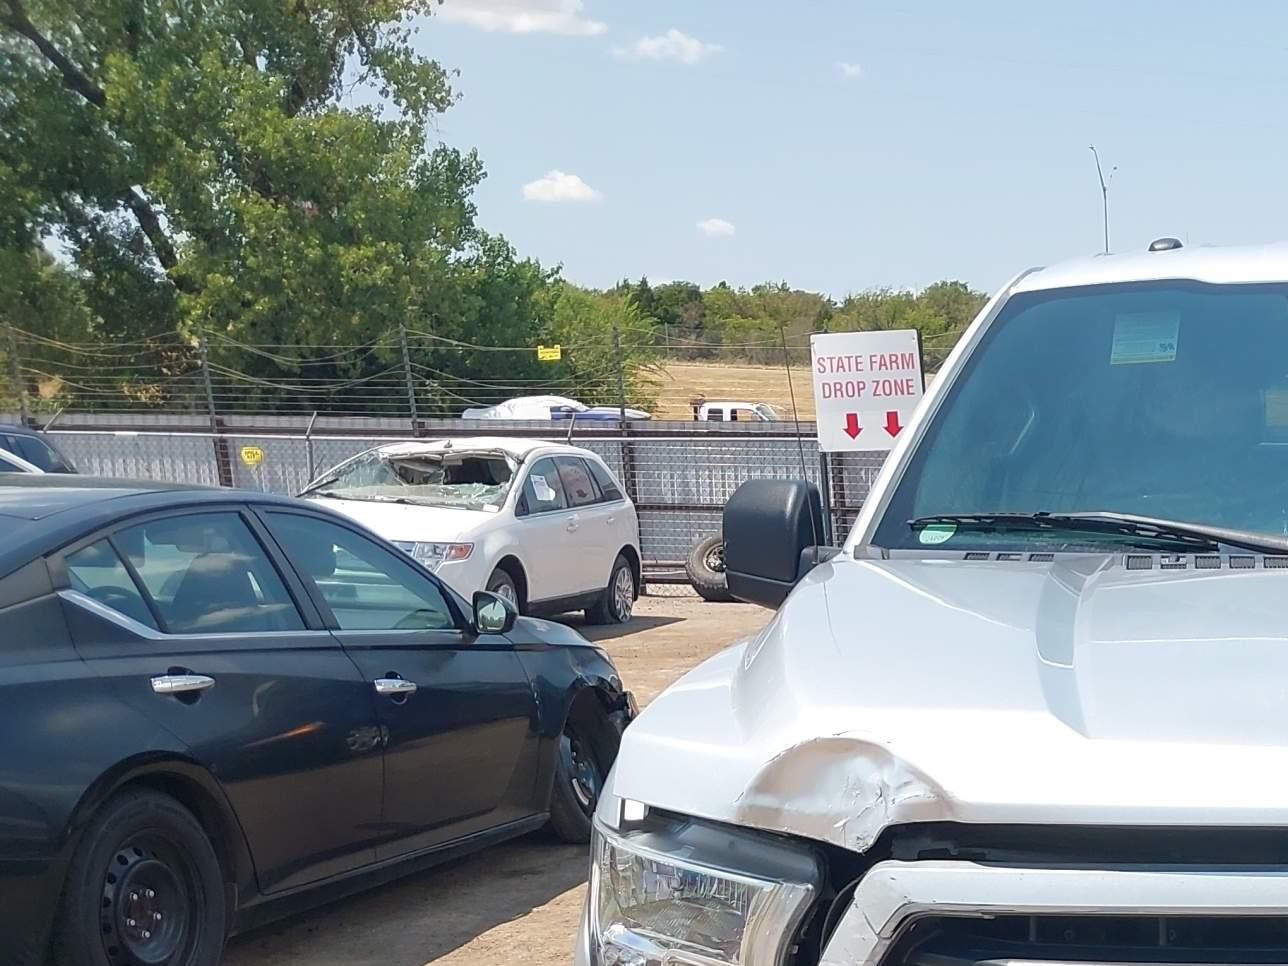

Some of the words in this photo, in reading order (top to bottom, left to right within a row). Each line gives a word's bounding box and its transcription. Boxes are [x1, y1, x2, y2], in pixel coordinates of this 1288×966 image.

[817, 355, 864, 374] STATE
[869, 352, 915, 371] FARM
[822, 381, 866, 399] DROP
[872, 379, 915, 397] ZONE
